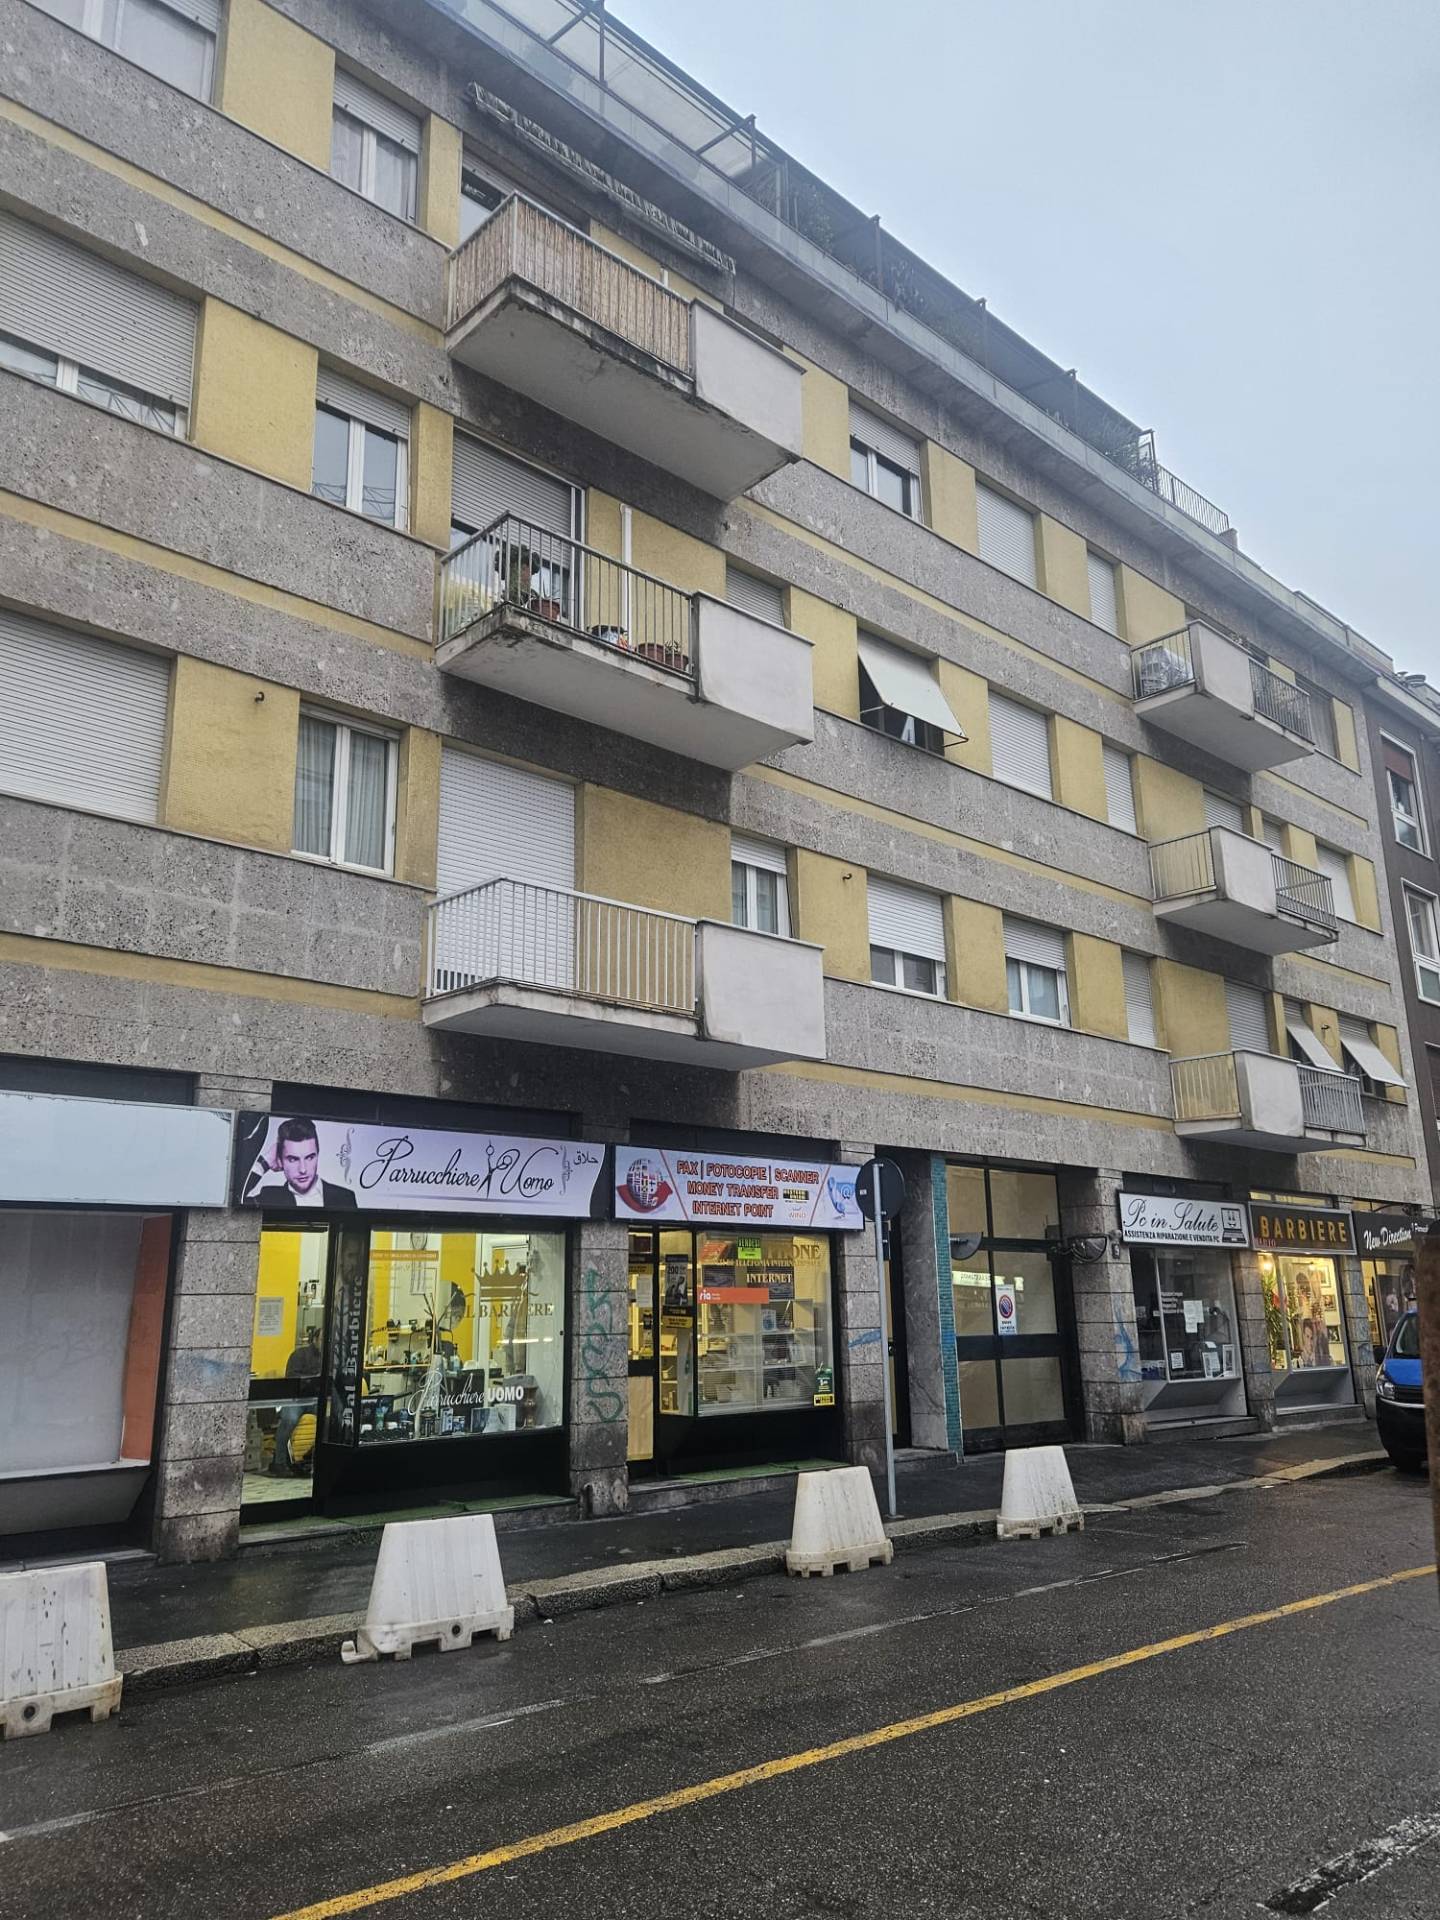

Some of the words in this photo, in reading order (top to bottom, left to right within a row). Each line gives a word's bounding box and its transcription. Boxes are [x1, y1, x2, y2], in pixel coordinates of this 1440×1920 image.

[360, 1136, 480, 1190] Parrucchiere
[500, 1147, 559, 1198] Uomo
[573, 1151, 599, 1166] حلاق
[676, 1160, 699, 1175] FAX
[706, 1163, 768, 1180] FOTOCOPIE
[774, 1168, 820, 1184] SCANNER
[687, 1181, 725, 1196] MONEY
[726, 1183, 779, 1200] TRANSFER
[692, 1201, 742, 1217] INTERNET
[744, 1203, 774, 1218] POINT
[1150, 1212, 1168, 1229] in
[1168, 1201, 1219, 1232] Salute
[1124, 1229, 1155, 1240] ASSISTENZA
[1156, 1231, 1189, 1241] RIPARAZIONE
[1260, 1215, 1348, 1243] BARBIERE
[1363, 1229, 1381, 1251] New
[746, 1273, 793, 1284] INTERNET
[344, 1275, 364, 1376] Barbiere
[487, 1385, 525, 1403] UOMO
